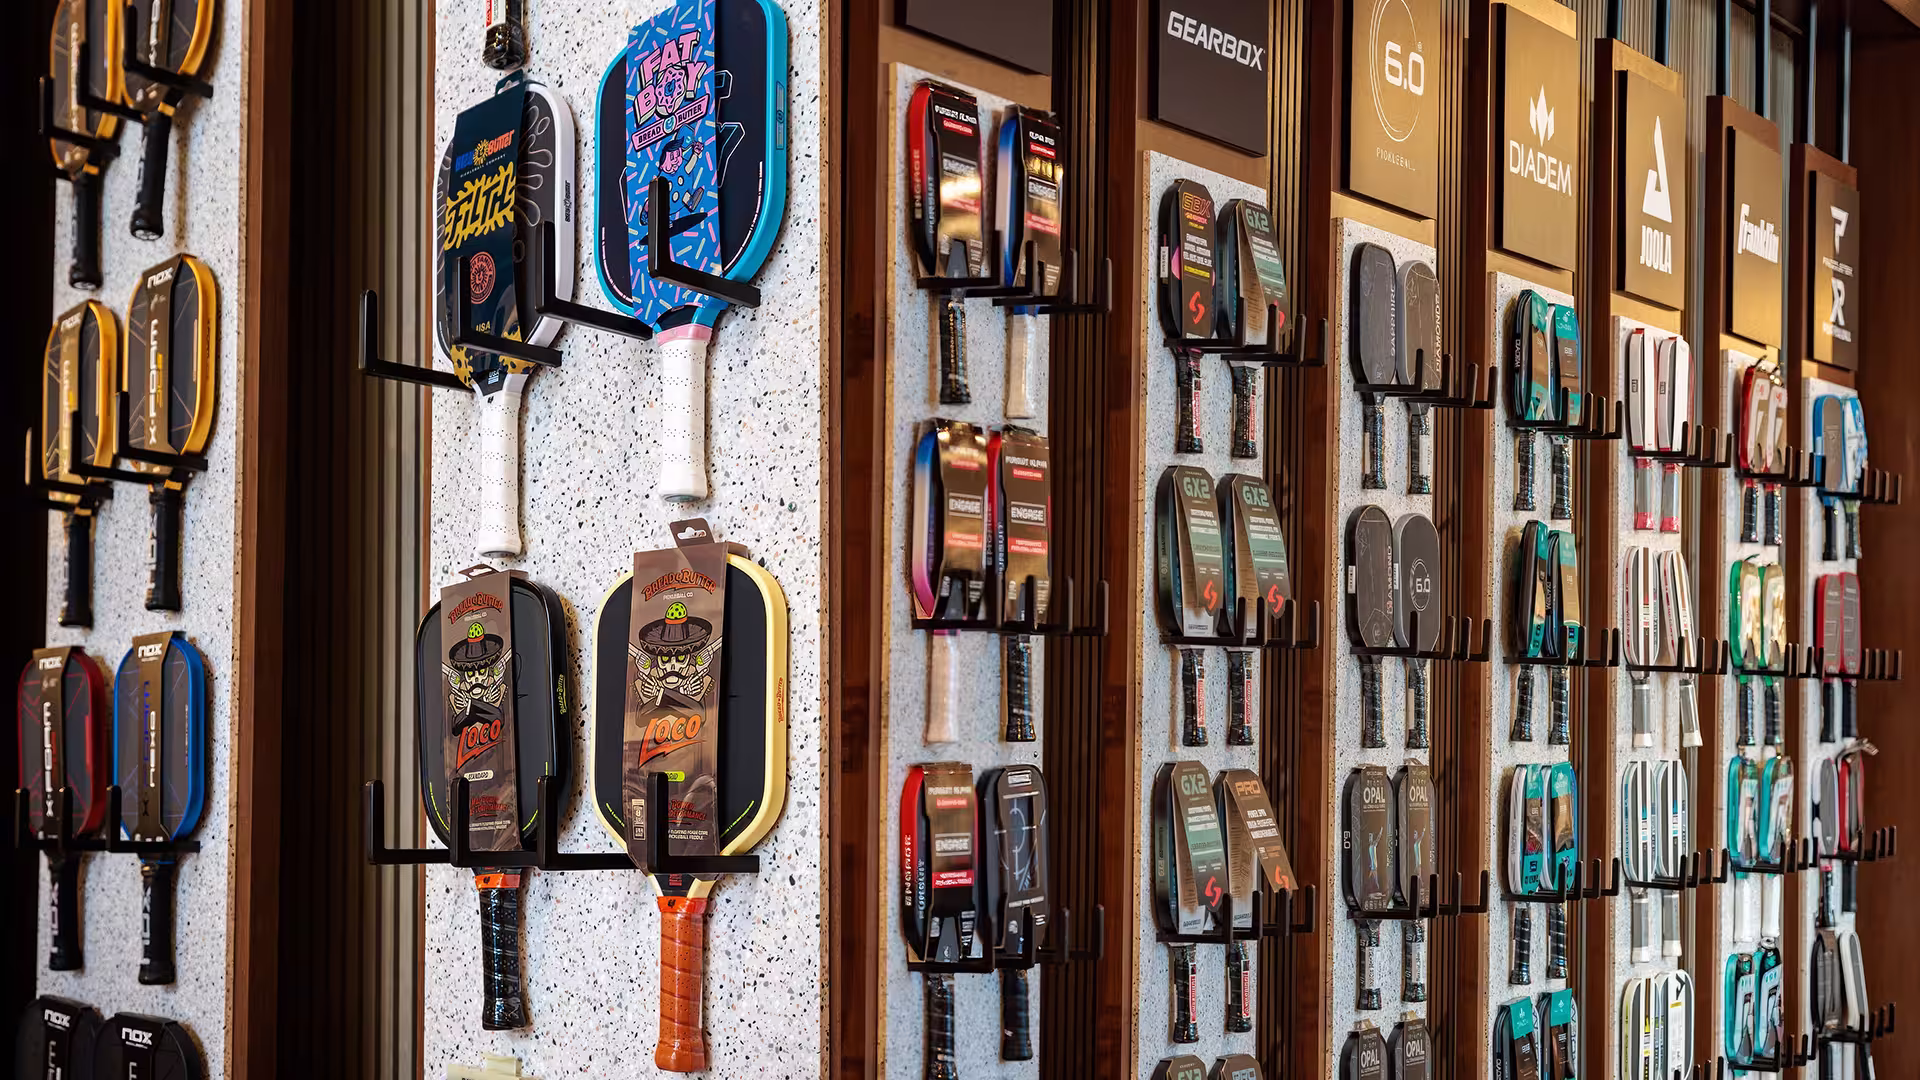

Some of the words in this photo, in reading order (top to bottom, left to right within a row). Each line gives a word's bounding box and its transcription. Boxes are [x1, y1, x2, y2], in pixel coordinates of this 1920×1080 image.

[1167, 10, 1263, 71] GEARBOX
[640, 30, 701, 87] FAT
[1385, 40, 1425, 96] 6.0
[638, 126, 661, 144] BREAD
[677, 104, 703, 123] BUTTER
[1509, 139, 1572, 196] DIADEM
[1245, 208, 1270, 233] GX2
[1639, 224, 1672, 274] JOOLA
[1183, 476, 1211, 499] GX2
[1242, 485, 1270, 508] GX2
[641, 572, 675, 601] BREAD
[681, 568, 717, 594] BUTTER
[1415, 578, 1431, 593] 6.0
[456, 719, 503, 774] LOCO
[638, 714, 703, 769] LOCO
[1181, 773, 1208, 796] GX2
[1235, 780, 1261, 796] PRO
[1363, 786, 1386, 804] OPAL
[1409, 786, 1429, 802] OPAL
[1360, 1050, 1380, 1068] OPAL
[1406, 1039, 1425, 1057] OPAL
